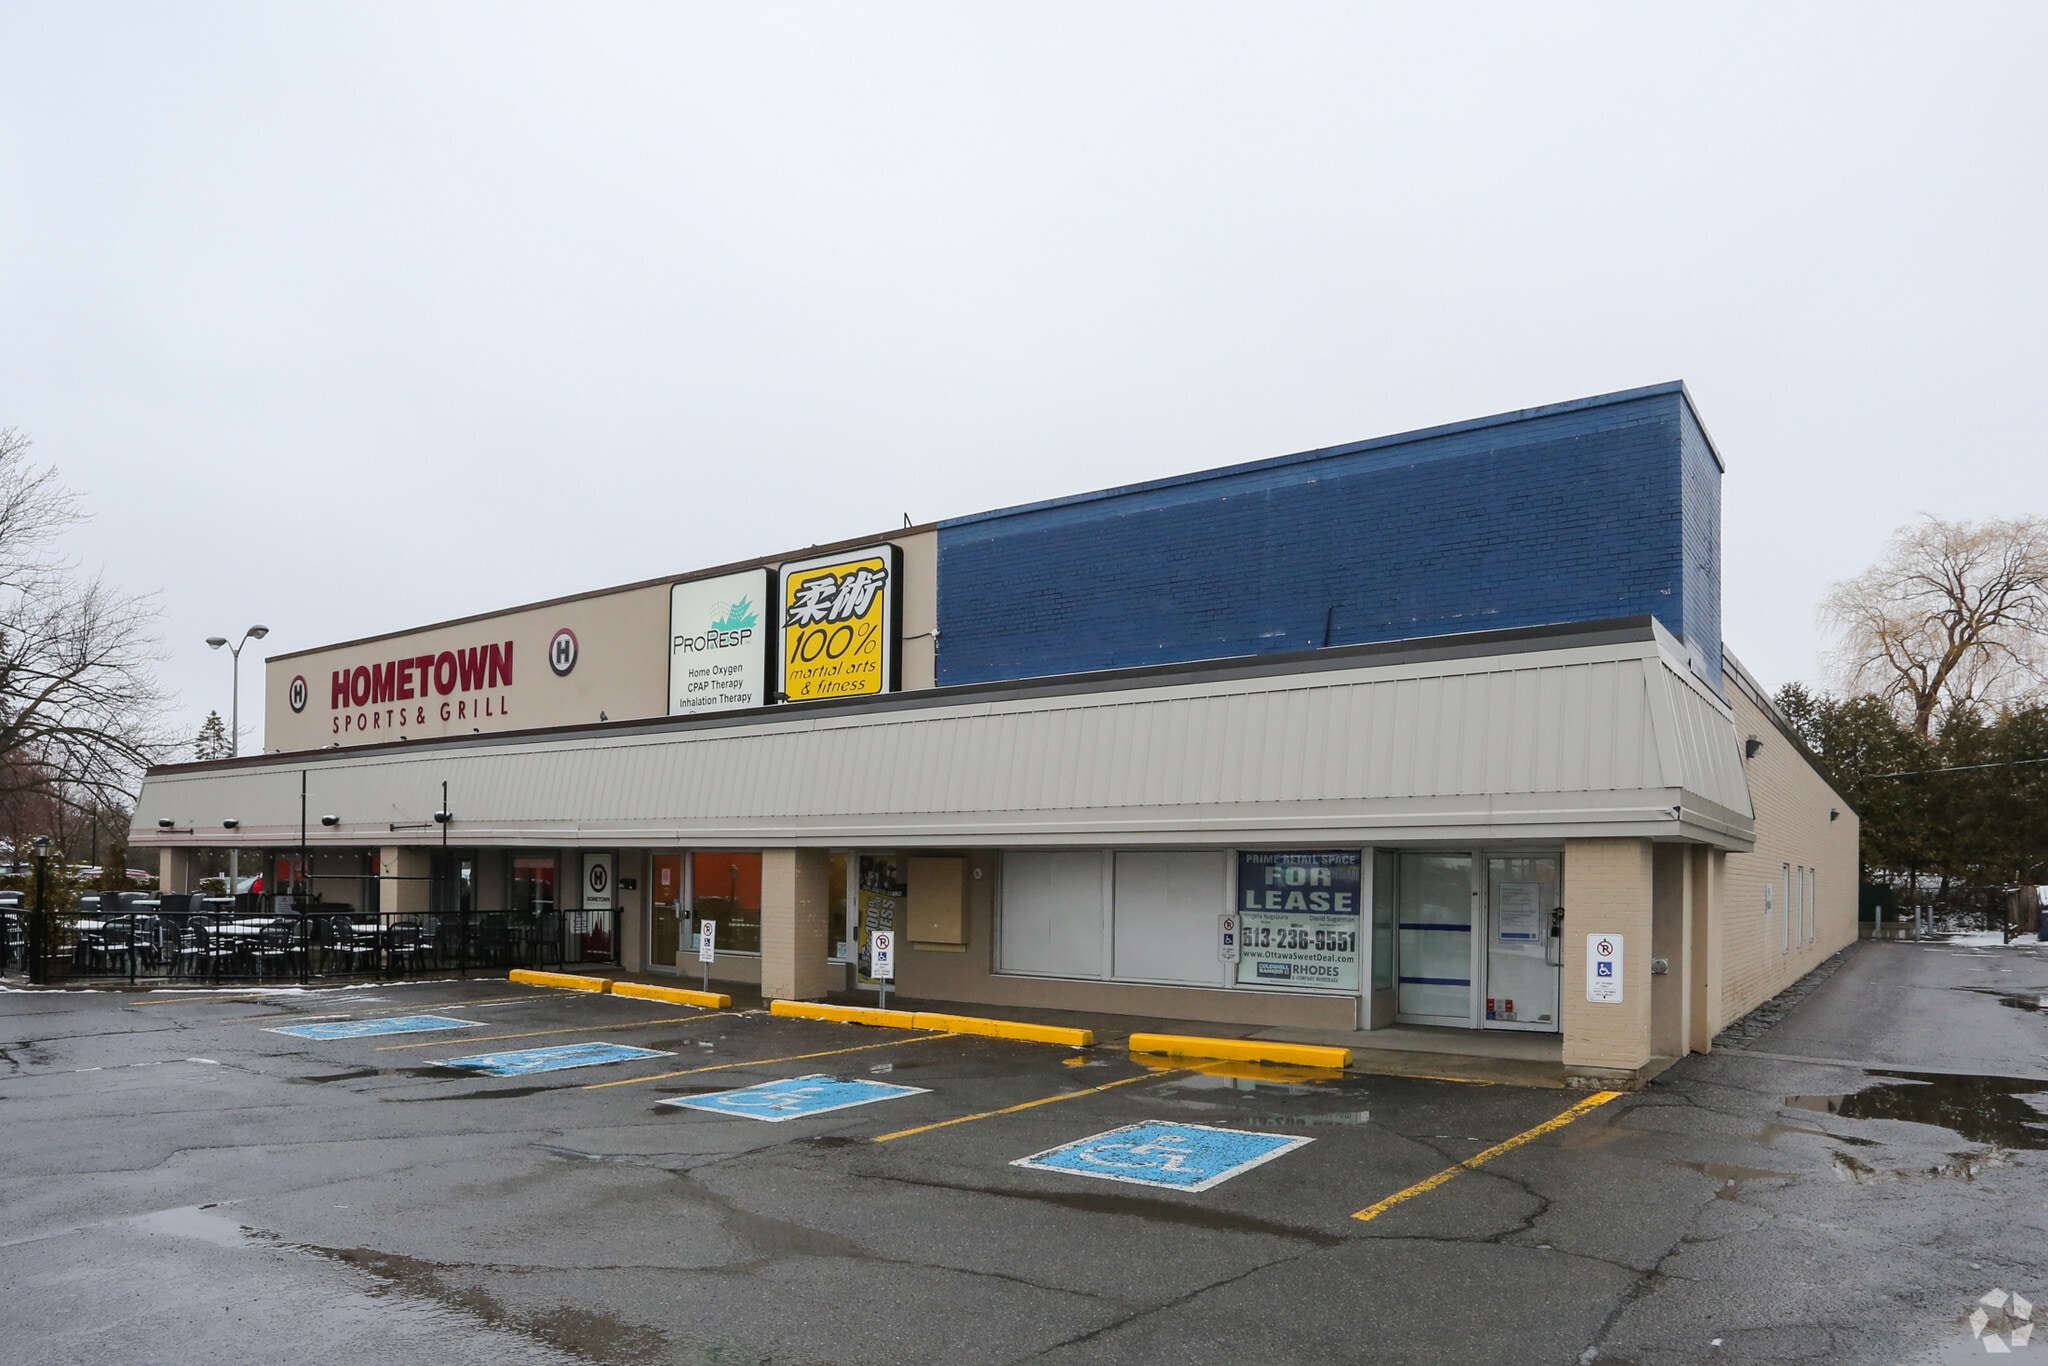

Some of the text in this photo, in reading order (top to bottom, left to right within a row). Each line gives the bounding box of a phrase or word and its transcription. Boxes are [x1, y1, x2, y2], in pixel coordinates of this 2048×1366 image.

[784, 569, 888, 627] 柔術
[790, 622, 878, 664] 100%
[331, 640, 513, 709] HOMETOWN
[688, 664, 743, 678] Home Oxygen
[790, 661, 876, 680] martial arts
[688, 679, 743, 692] CPAP Therapy
[801, 679, 866, 695] & fitness
[680, 693, 752, 708] Inhalation Therapy
[332, 695, 508, 734] SPORTS & GRILL
[1246, 854, 1356, 865] PRIME RETAIL SPACE
[1265, 866, 1331, 887] FOR
[1246, 890, 1352, 912] LEASE
[1243, 927, 1356, 952] 613-236-9551
[1243, 951, 1355, 963] www.OttawaSweetDeal.com
[1292, 964, 1339, 976] RHODES
